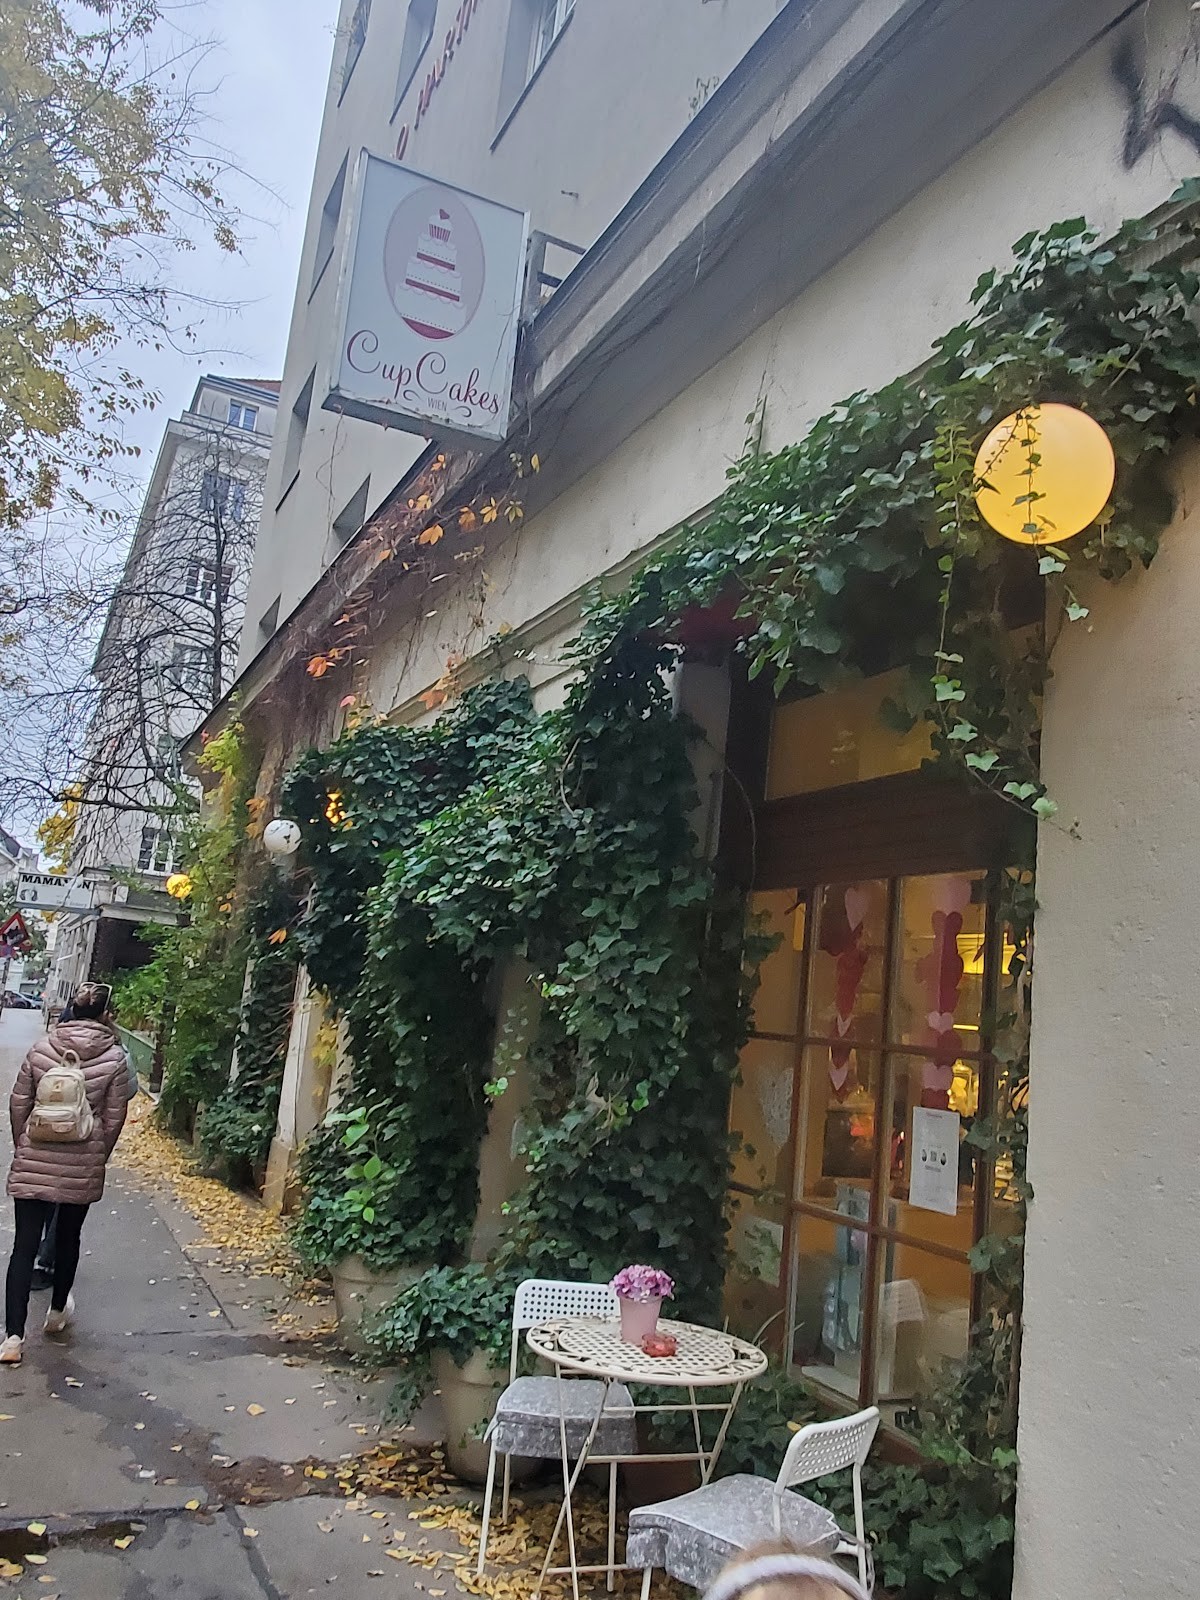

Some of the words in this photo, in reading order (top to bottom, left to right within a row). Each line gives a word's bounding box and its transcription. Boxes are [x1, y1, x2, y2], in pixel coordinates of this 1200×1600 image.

[346, 329, 499, 414] CupCakes
[427, 397, 448, 412] WIEN
[21, 874, 91, 889] MAMAN
